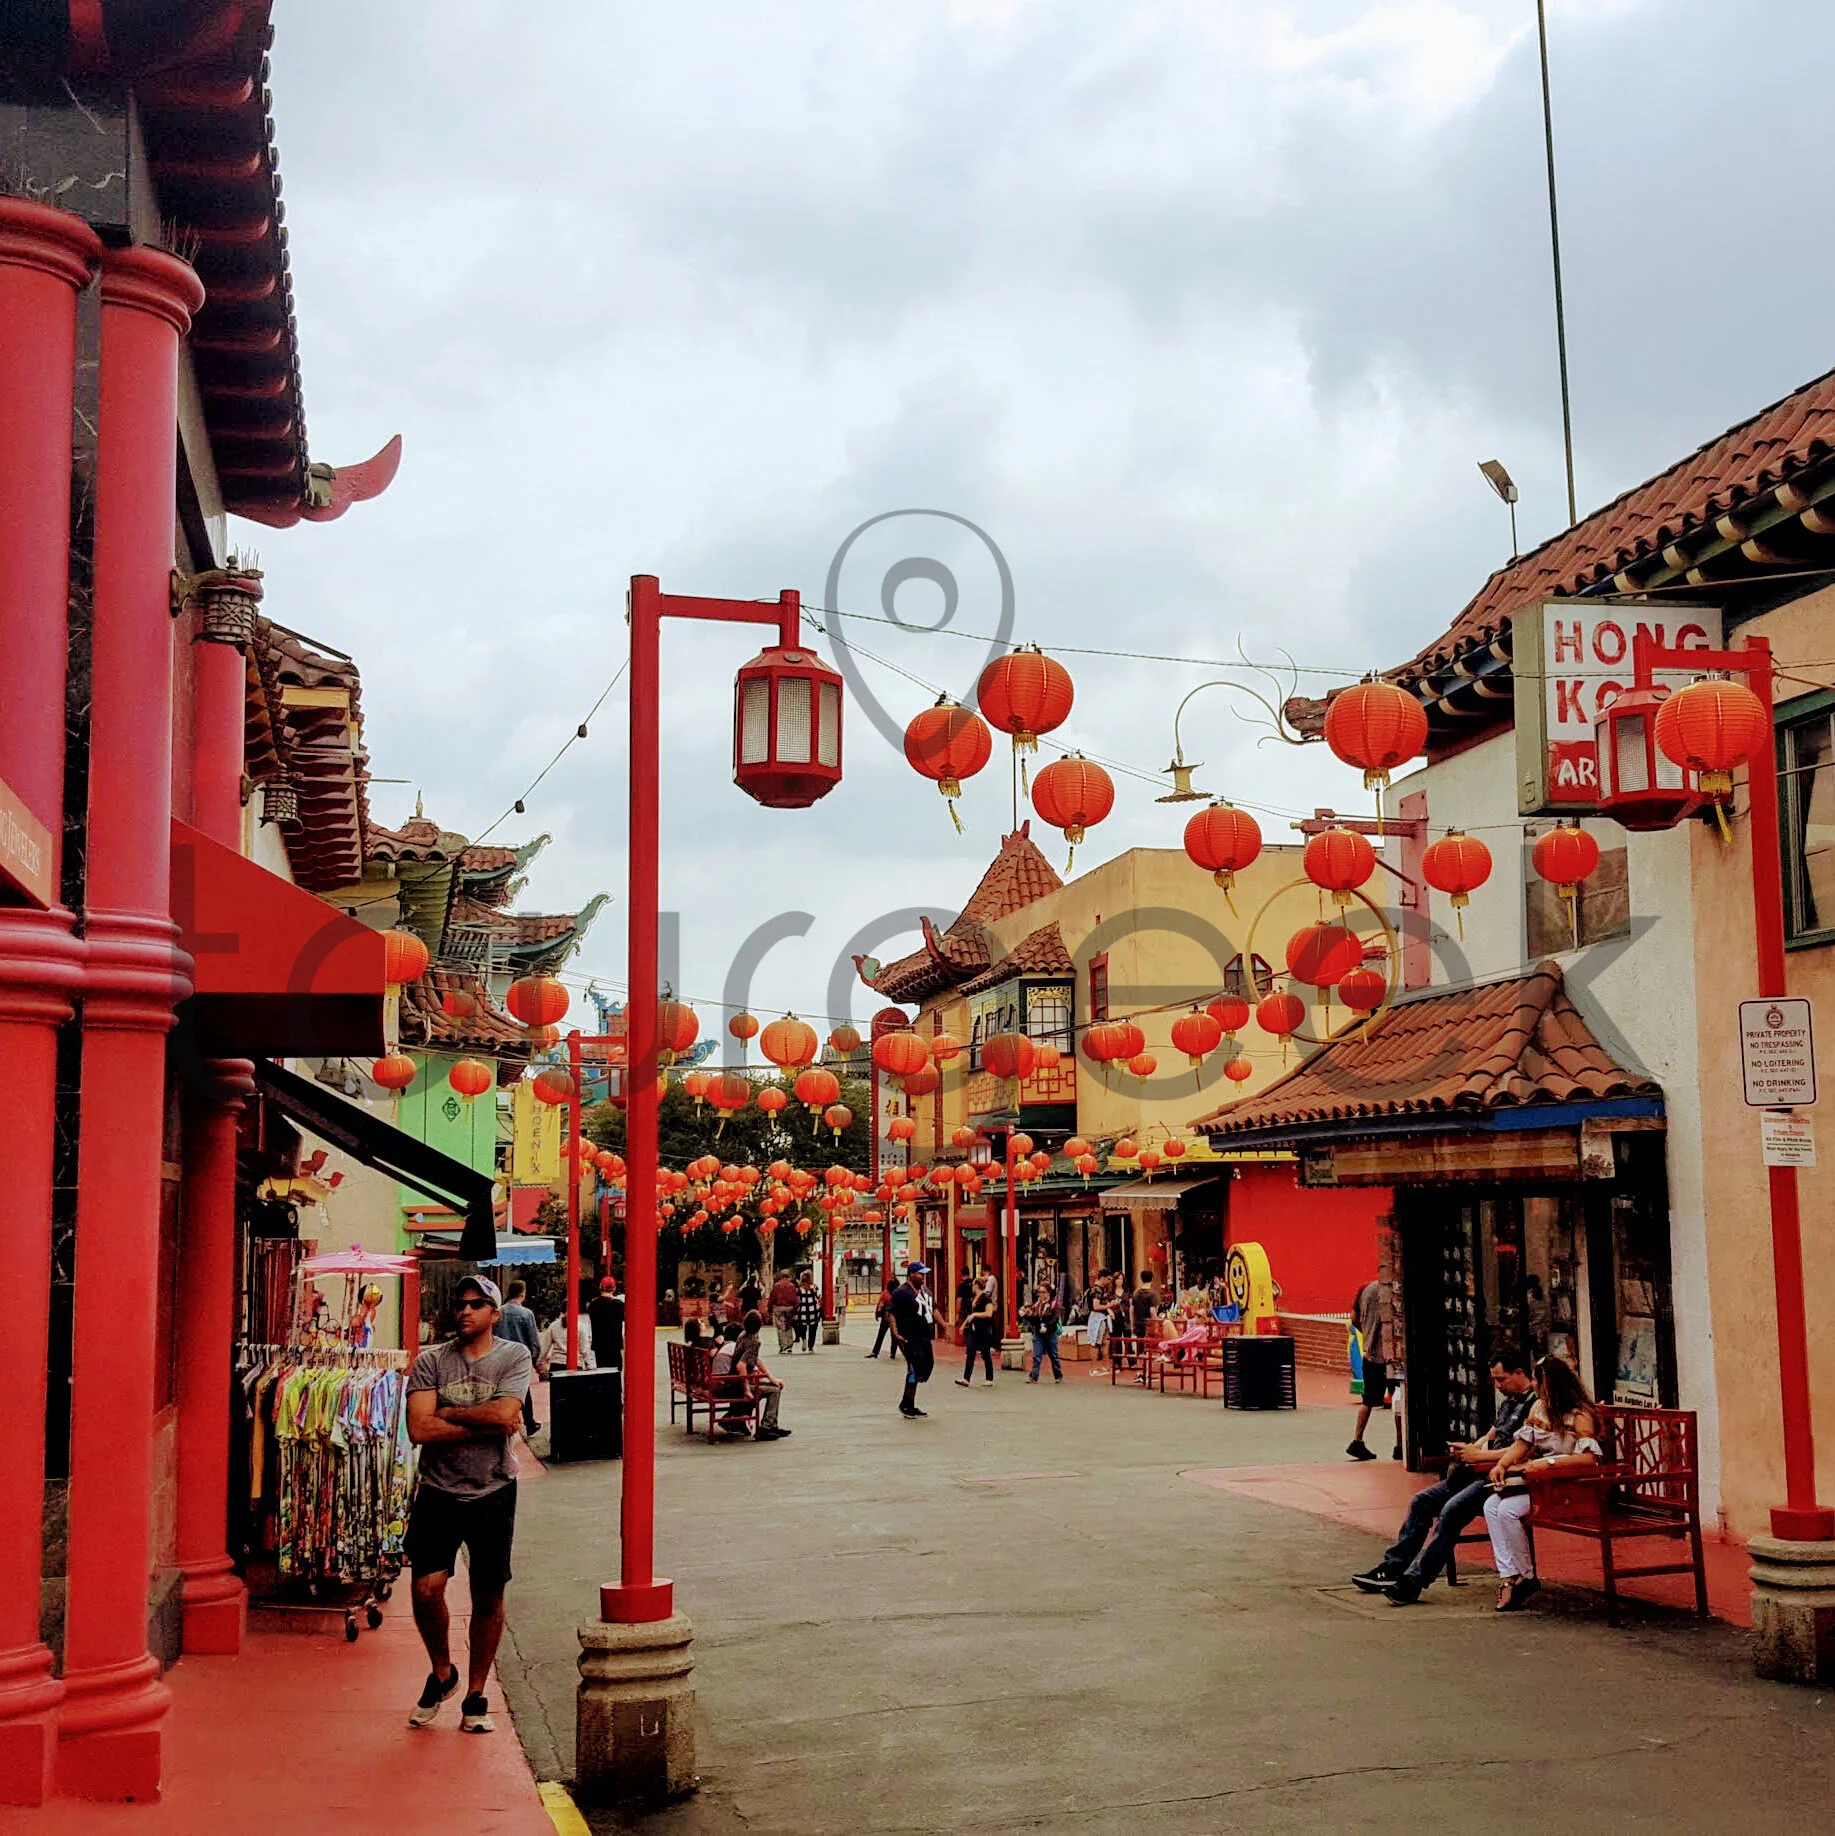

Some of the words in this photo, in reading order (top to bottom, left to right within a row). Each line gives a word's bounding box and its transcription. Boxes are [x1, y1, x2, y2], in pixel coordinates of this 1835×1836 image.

[1554, 620, 1710, 666] HONG
[1557, 756, 1598, 788] AR
[1746, 1031, 1772, 1039] PRIVATE
[1773, 1029, 1806, 1038] PROPERTY
[1761, 1040, 1803, 1048] TRESPASSING
[1751, 1060, 1761, 1068] NO
[1764, 1059, 1805, 1067] LOITERING
[1752, 1080, 1764, 1088] NO
[1766, 1078, 1806, 1087] DRINKING
[531, 1103, 543, 1174] HOENIX
